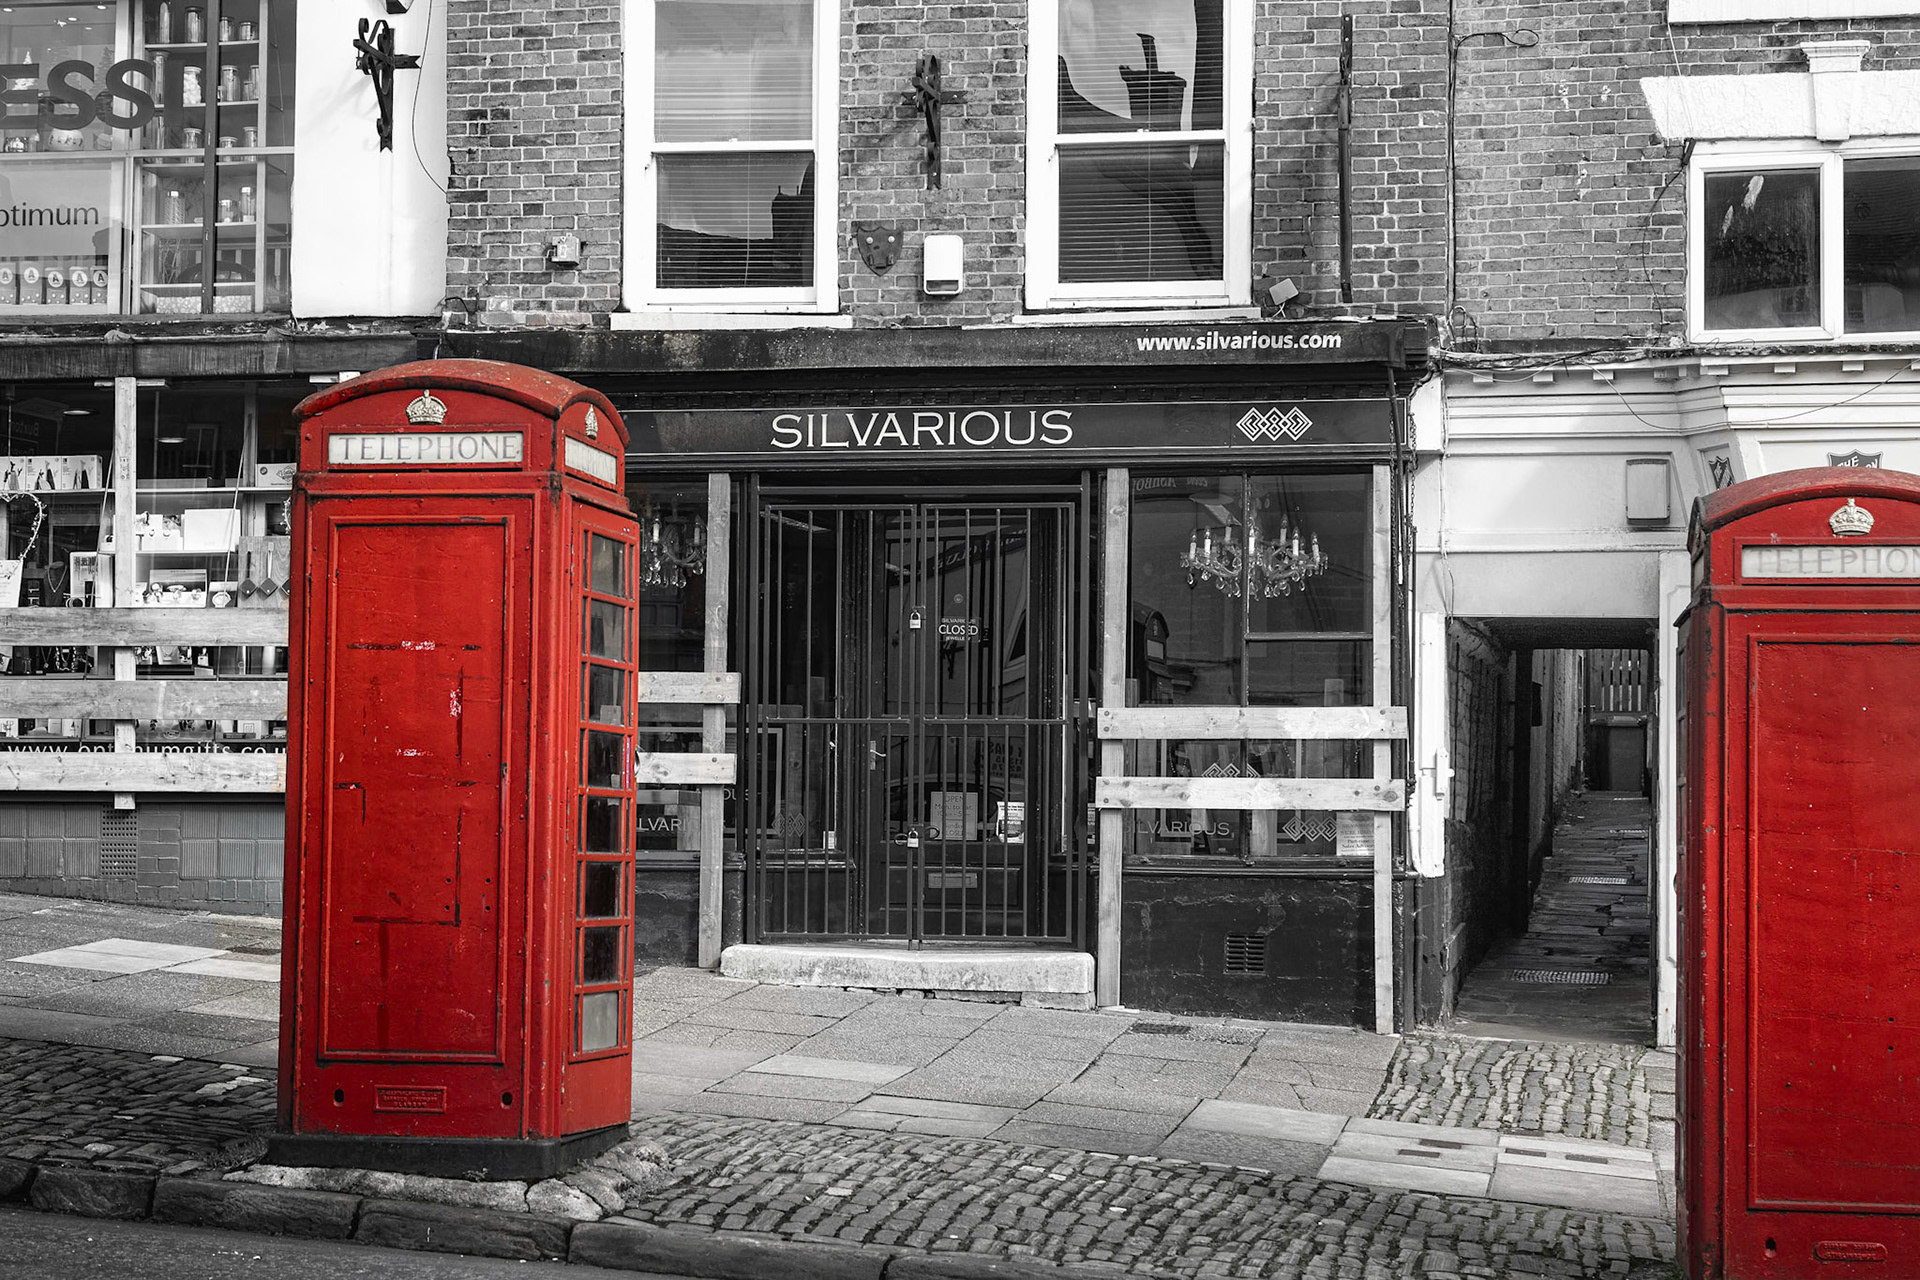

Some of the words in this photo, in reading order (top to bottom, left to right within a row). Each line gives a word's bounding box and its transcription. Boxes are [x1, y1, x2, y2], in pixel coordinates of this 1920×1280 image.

[1137, 331, 1342, 352] www.silvarious.com
[770, 409, 1074, 449] SILVARIOUS
[338, 434, 519, 461] TELEPHONE
